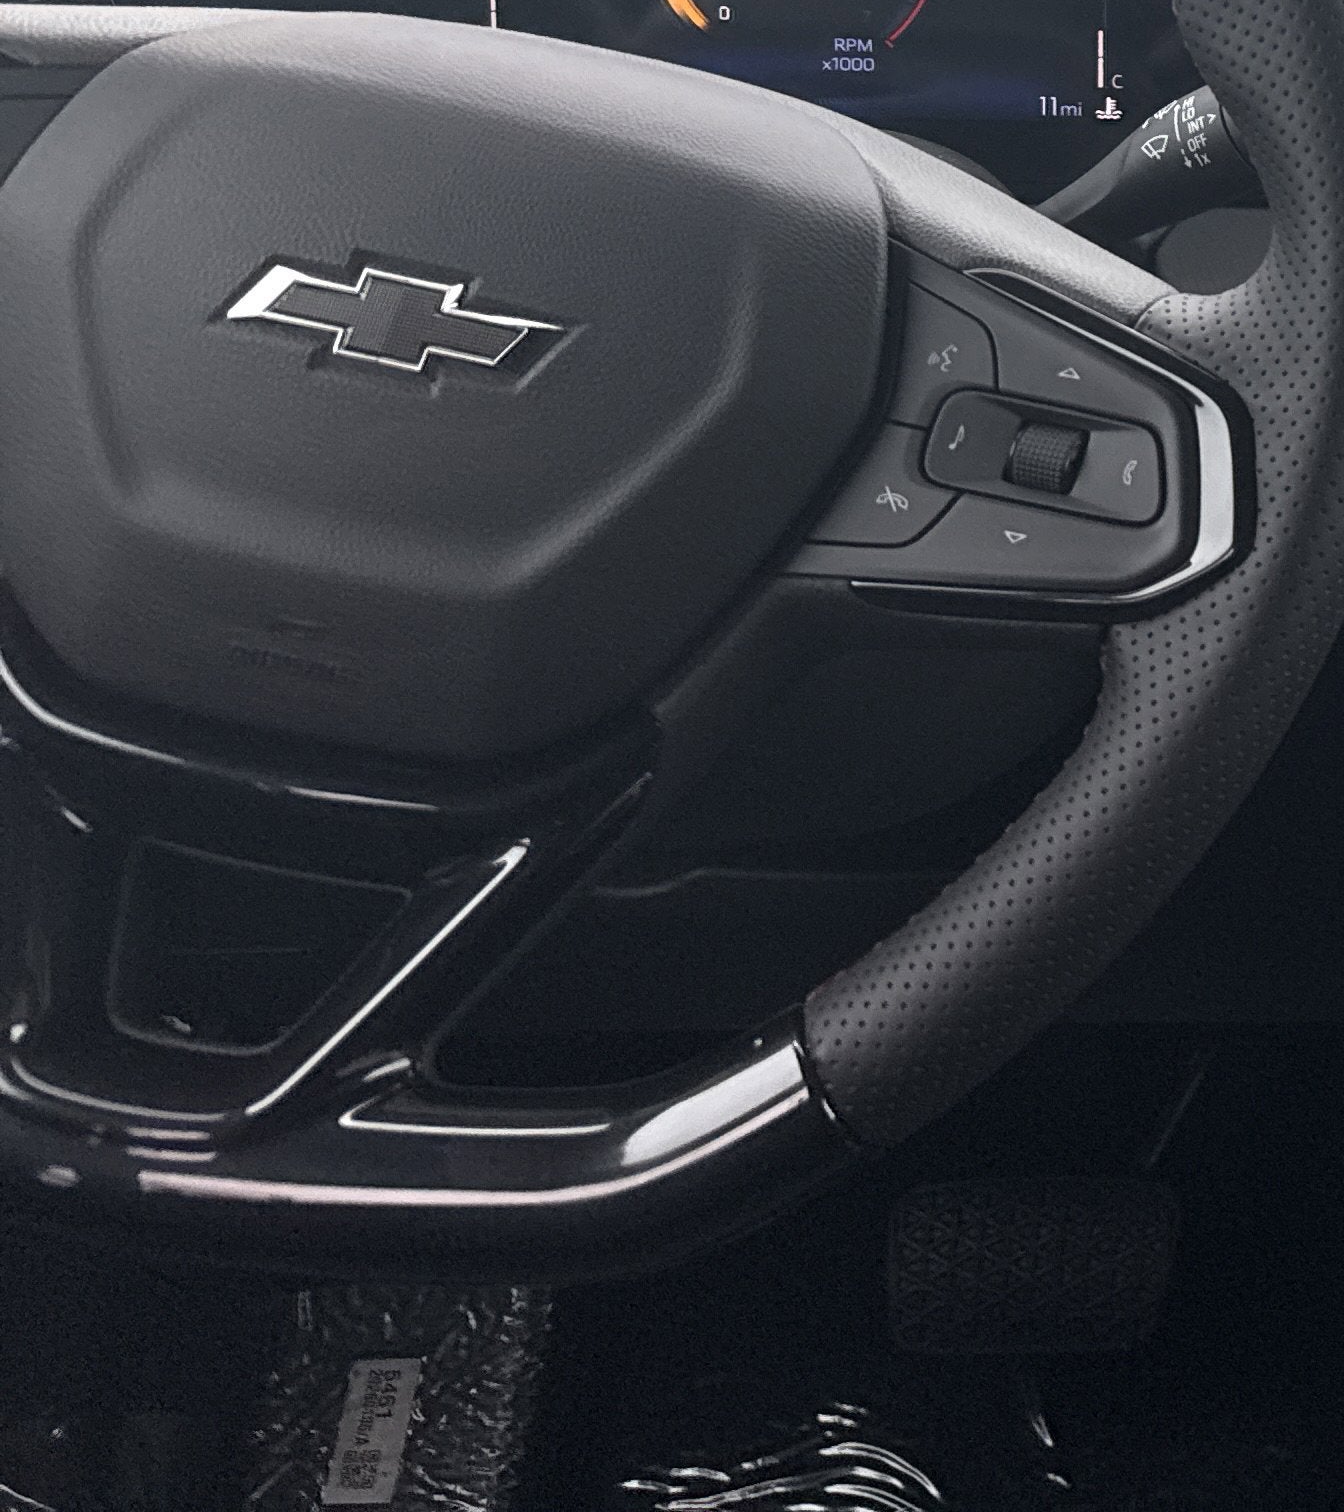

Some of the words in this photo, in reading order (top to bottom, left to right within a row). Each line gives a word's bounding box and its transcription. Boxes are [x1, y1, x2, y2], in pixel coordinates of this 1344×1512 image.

[718, 6, 731, 21] 0
[833, 38, 874, 53] RPM
[822, 57, 875, 72] x1000
[1112, 74, 1125, 89] C
[1182, 107, 1195, 122] LO
[1188, 115, 1205, 134] INT
[1187, 133, 1207, 152] OFF
